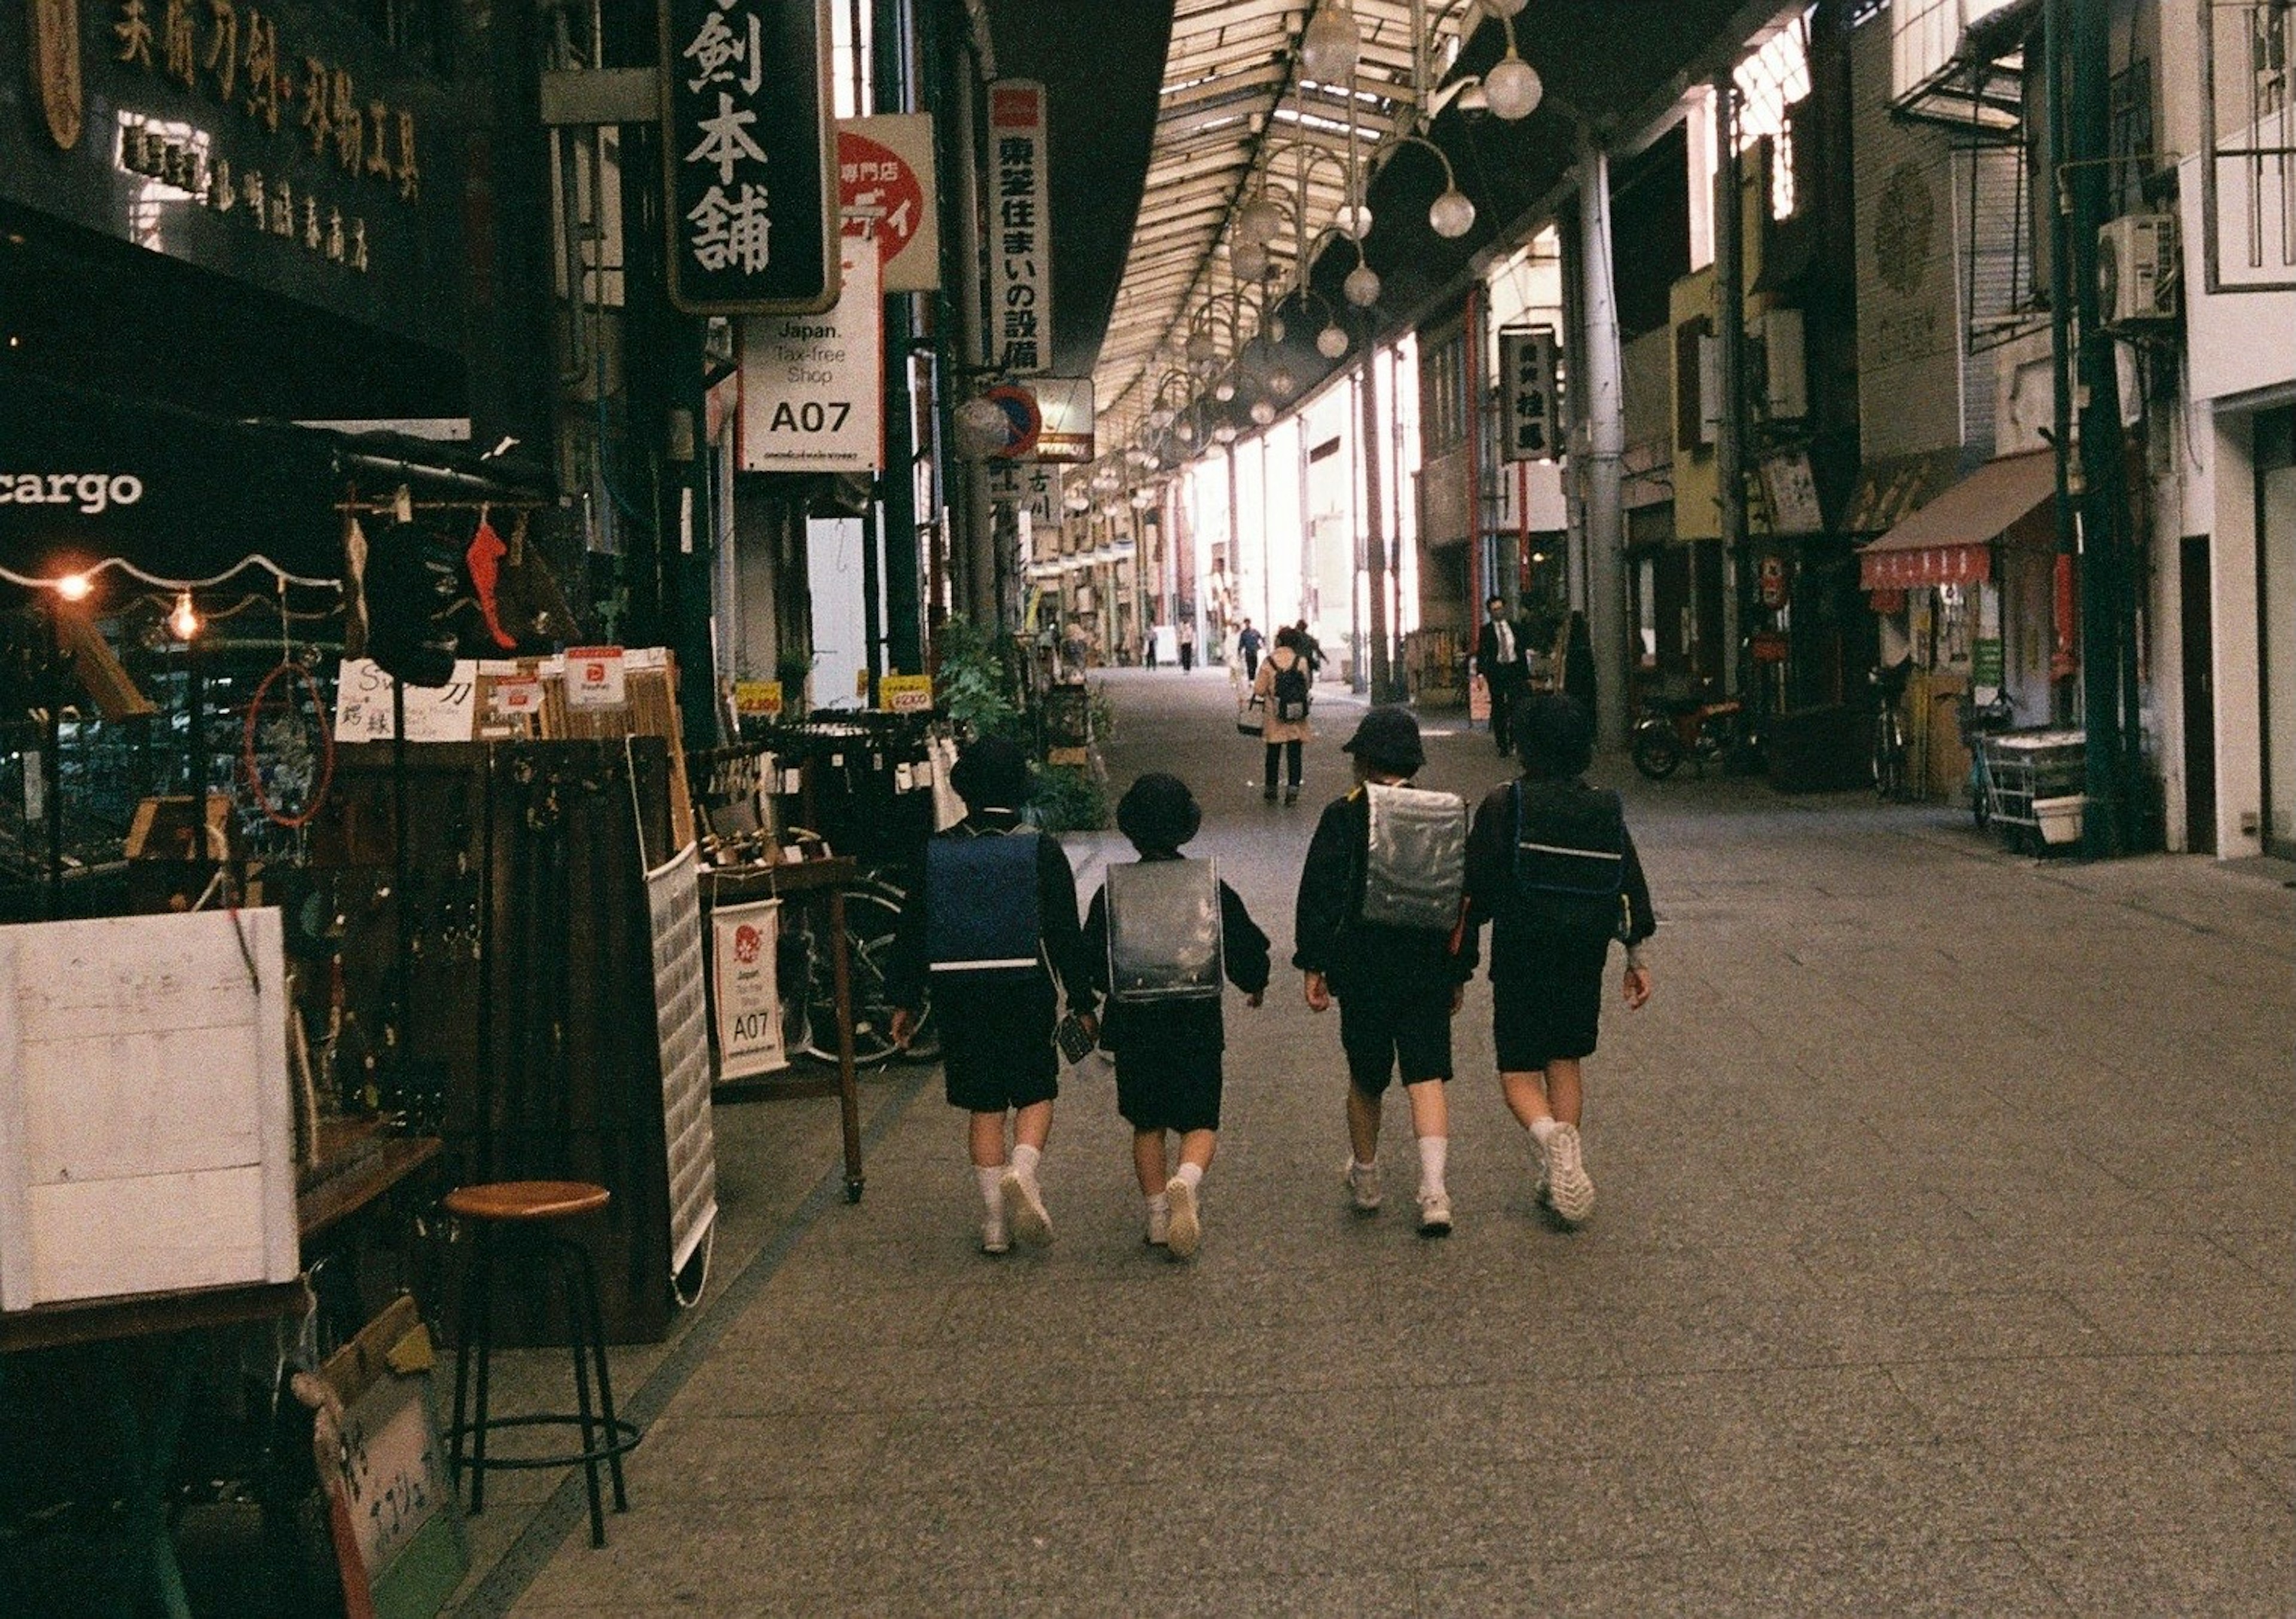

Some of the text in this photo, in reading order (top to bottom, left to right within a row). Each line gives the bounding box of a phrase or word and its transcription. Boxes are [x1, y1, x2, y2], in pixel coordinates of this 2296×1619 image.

[683, 0, 772, 276] 剣本舗
[787, 366, 832, 386] Shop
[770, 402, 851, 432] A07
[734, 1013, 768, 1042] A07
